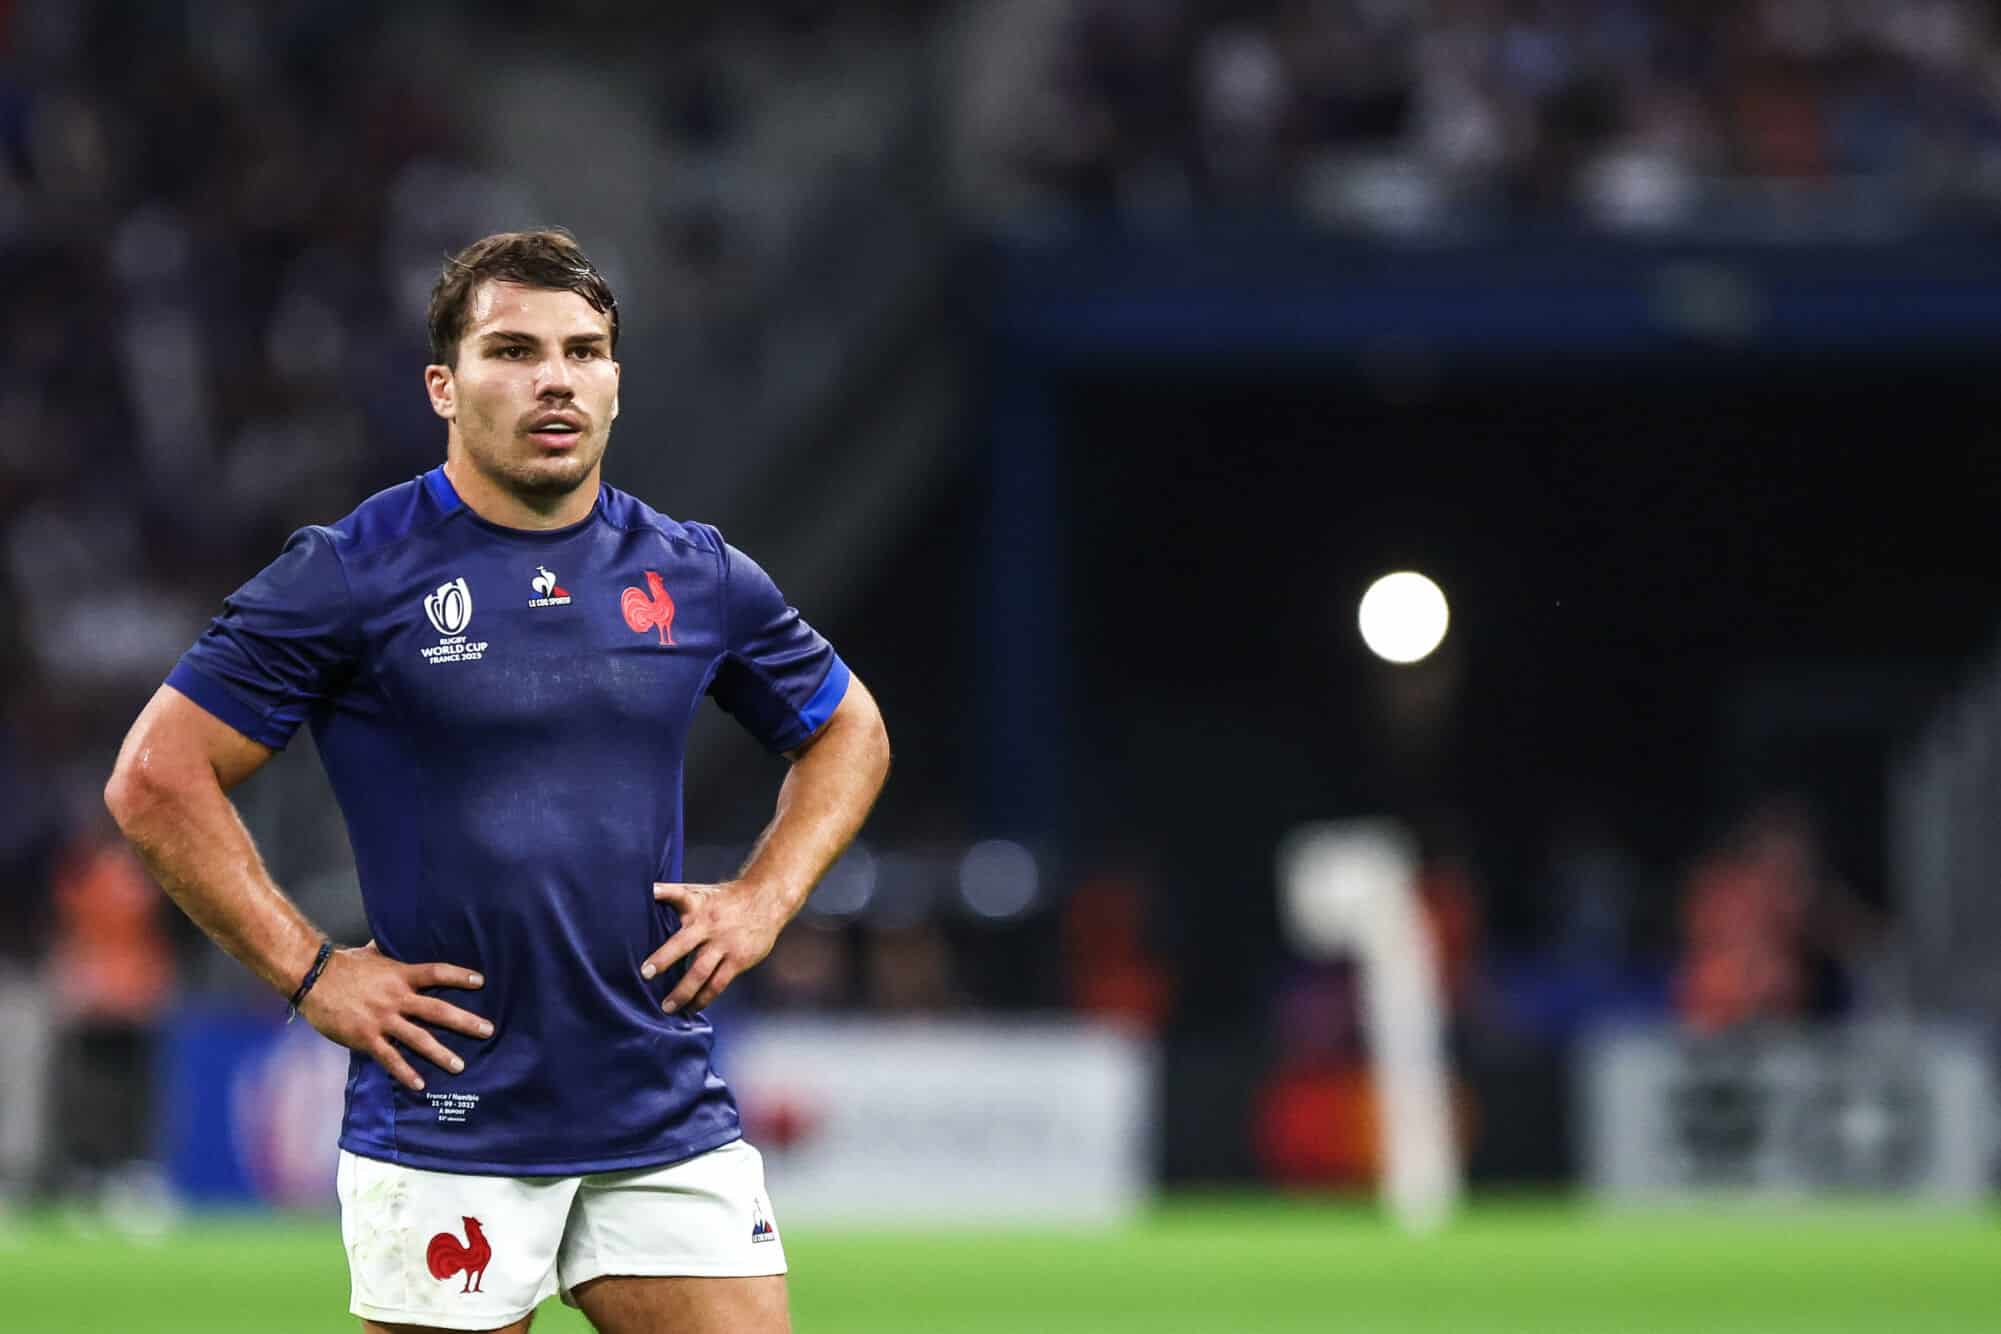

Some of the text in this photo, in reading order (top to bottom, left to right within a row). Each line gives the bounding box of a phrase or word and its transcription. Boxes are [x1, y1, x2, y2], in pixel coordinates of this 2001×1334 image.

[528, 599, 536, 607] LE
[537, 598, 548, 606] COQ
[440, 636, 467, 645] RUGBY
[420, 641, 488, 657] WORLD CUP
[430, 652, 482, 664] FRANCE 2023
